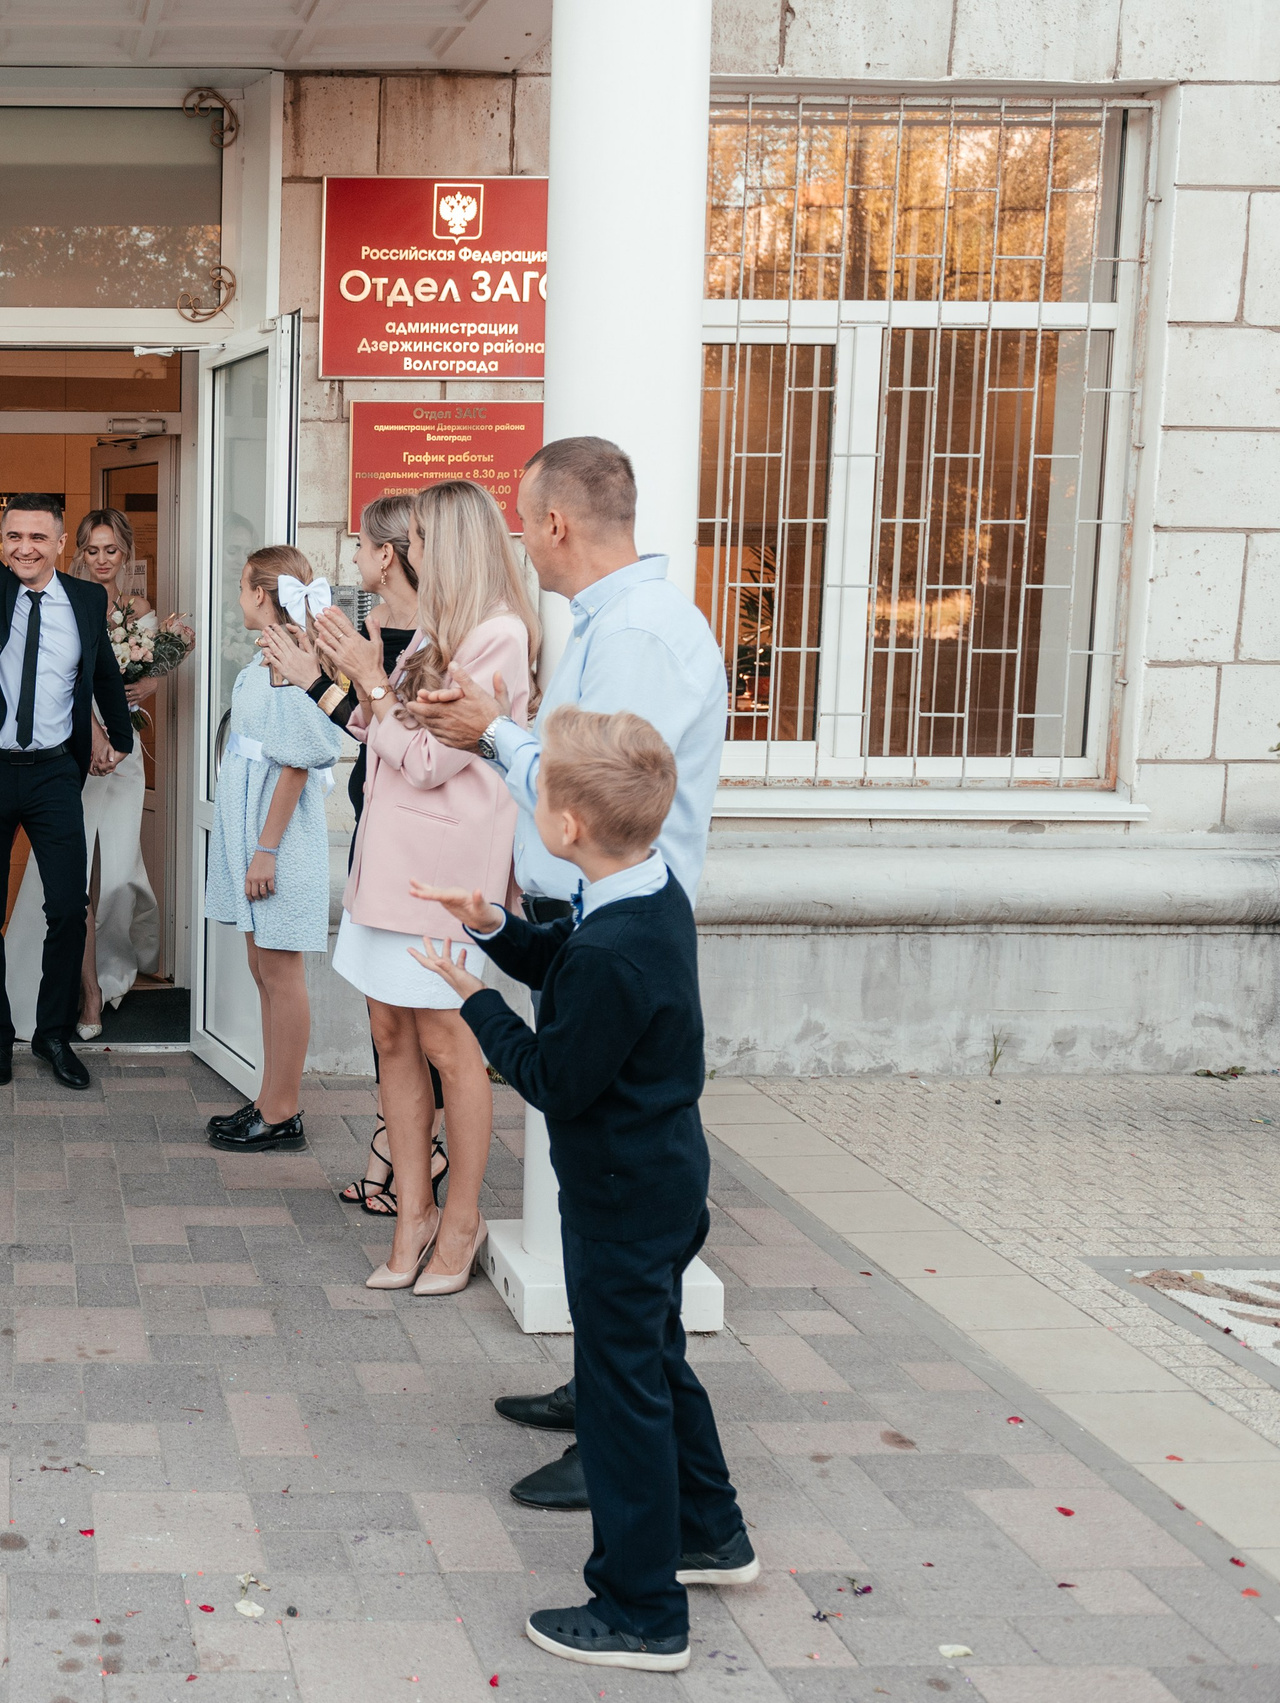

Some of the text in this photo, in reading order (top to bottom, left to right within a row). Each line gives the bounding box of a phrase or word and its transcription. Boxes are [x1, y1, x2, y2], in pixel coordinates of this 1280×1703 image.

[361, 246, 548, 264] Российская Федерация
[339, 269, 461, 308] Отдел
[385, 321, 519, 337] администрации
[357, 338, 545, 356] Дзержинского района
[403, 357, 499, 373] Волгограда
[412, 407, 488, 420] Отдел ЗАГС
[373, 423, 526, 433] администрации Дзержинского района
[426, 433, 473, 443] Волгограда
[403, 450, 495, 466] График работы:
[355, 471, 464, 480] понедельник-пятница
[465, 471, 471, 479] с
[472, 468, 496, 479] 8.30
[496, 471, 511, 480] до
